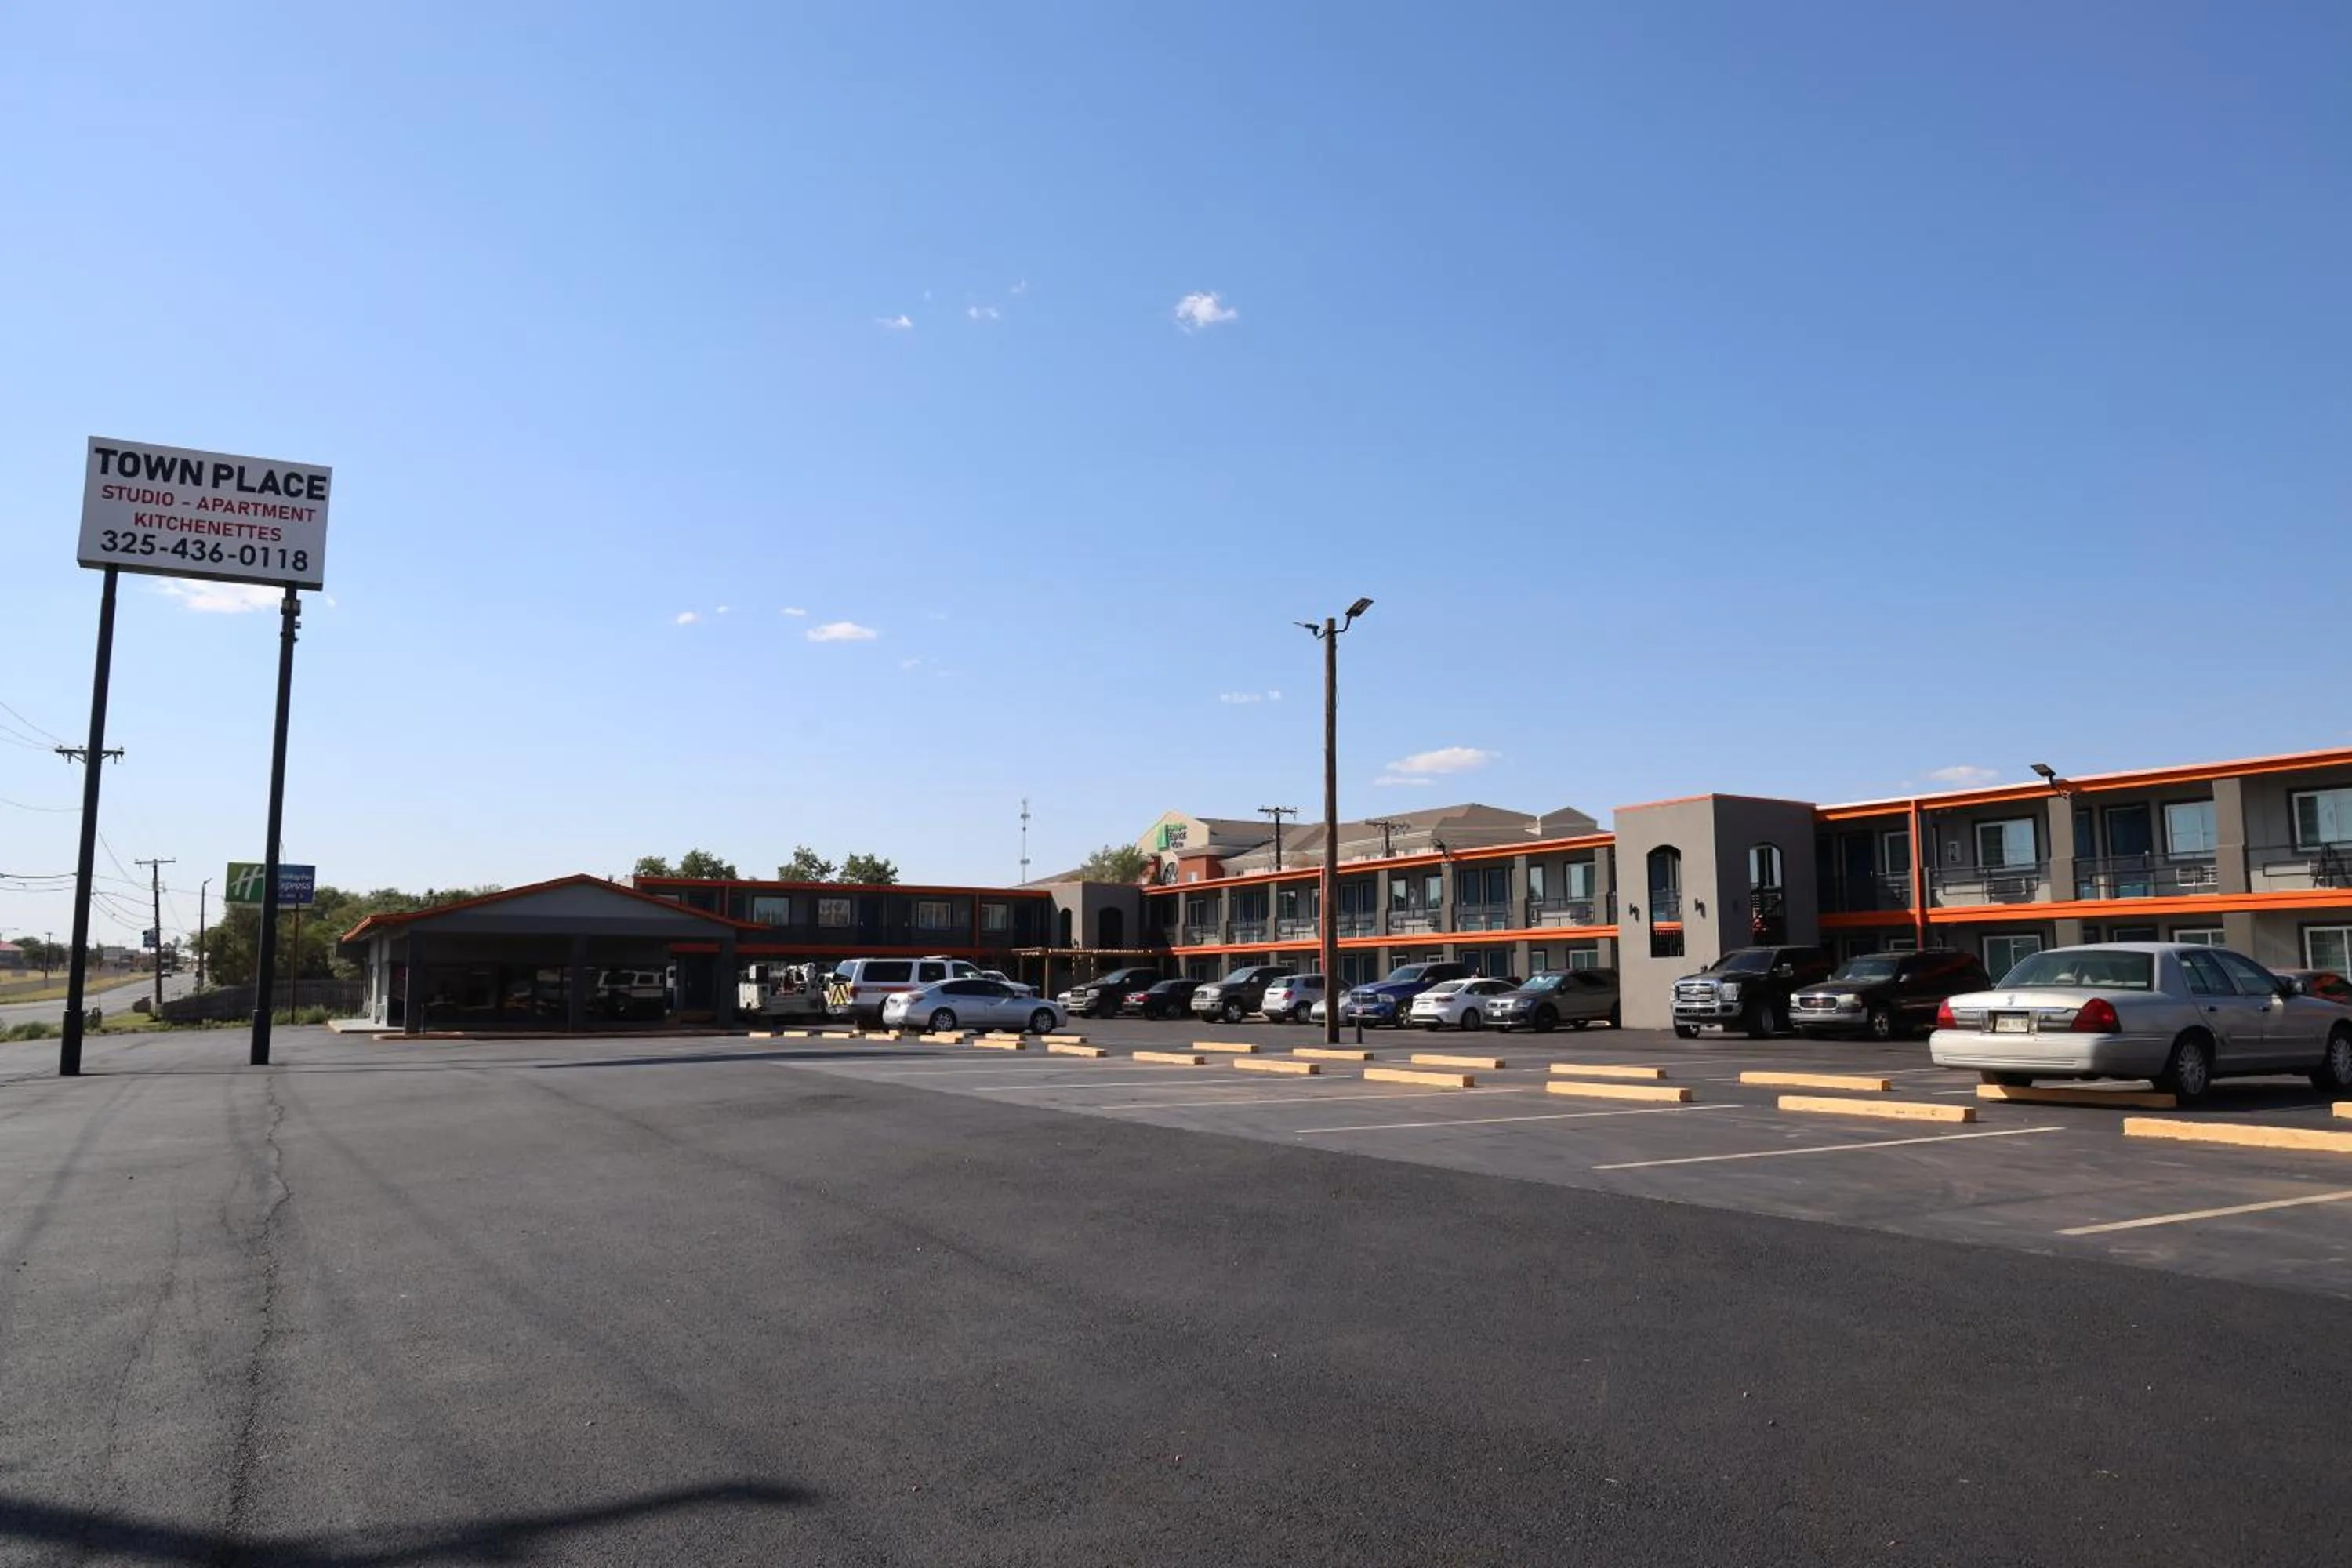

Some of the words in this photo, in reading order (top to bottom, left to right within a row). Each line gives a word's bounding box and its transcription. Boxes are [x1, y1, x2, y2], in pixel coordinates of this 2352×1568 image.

[95, 447, 204, 486] TOWN
[212, 463, 327, 501] PLACE
[101, 485, 174, 507] STUDIO
[197, 496, 316, 523] APARTMENT
[134, 512, 281, 542] KITCHENETTES
[100, 529, 308, 572] 325-436-0118
